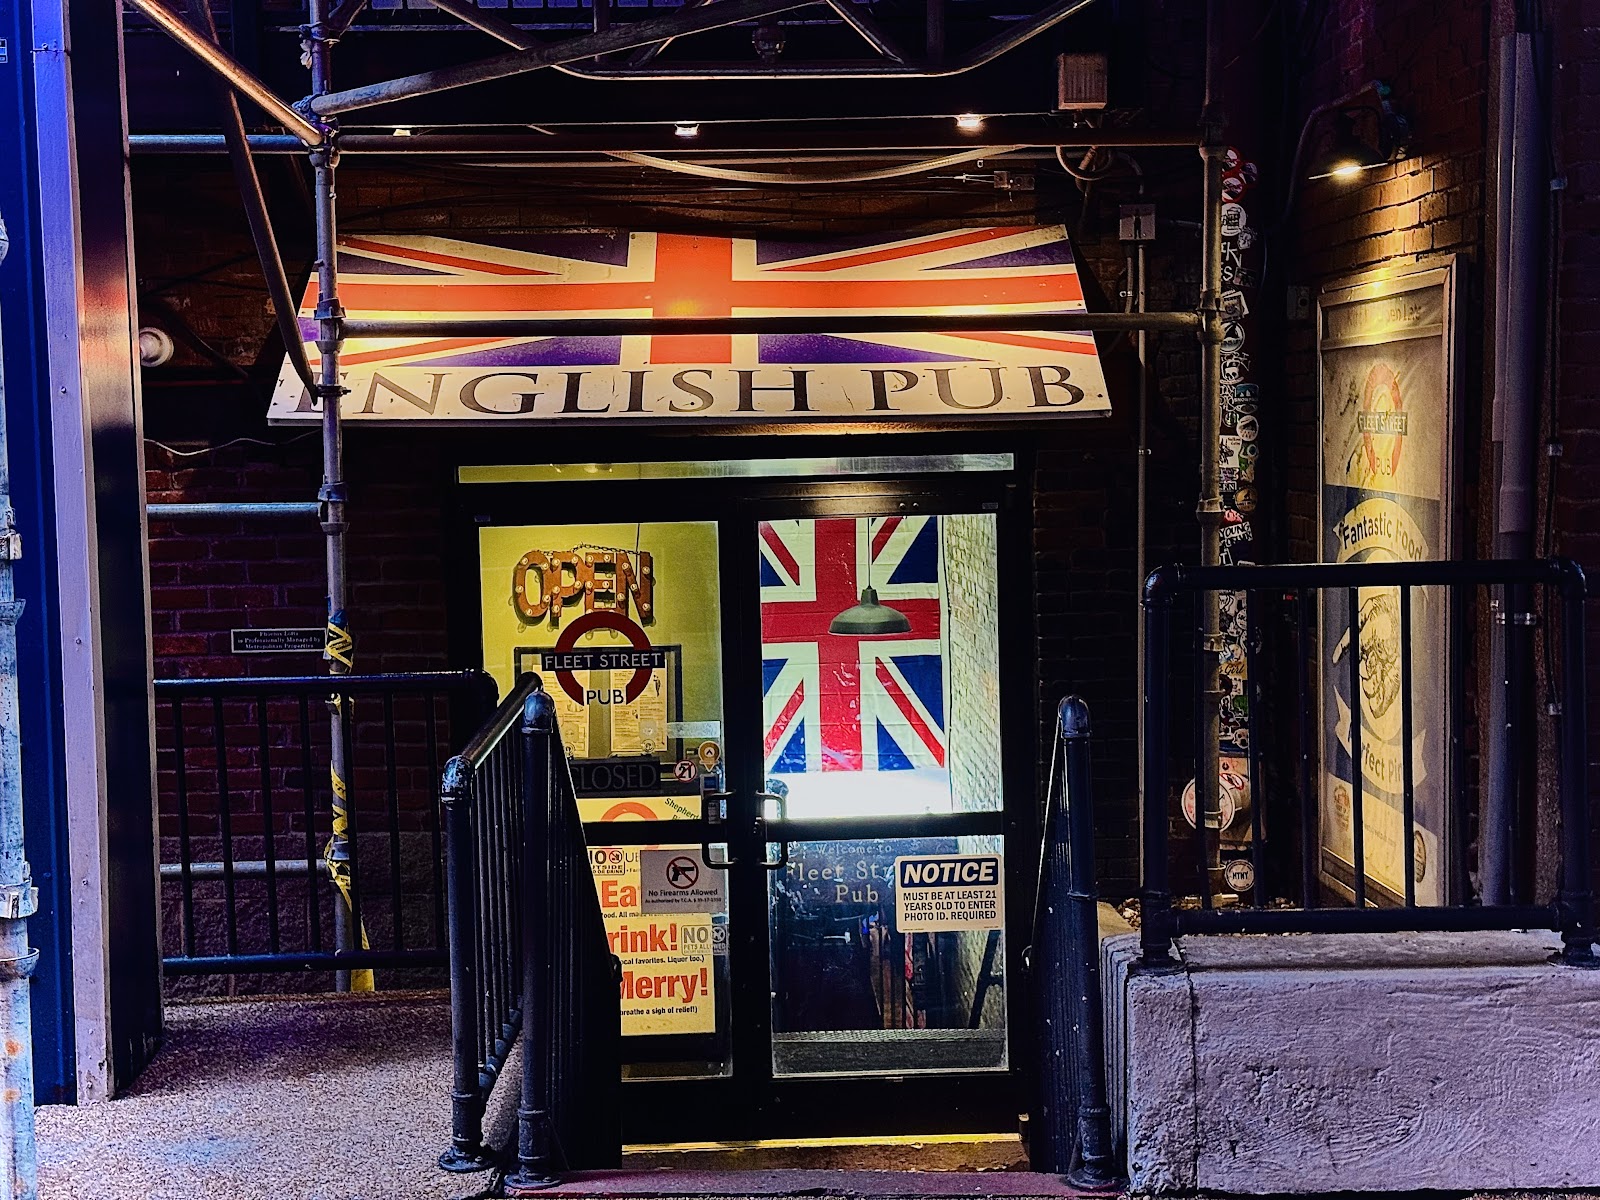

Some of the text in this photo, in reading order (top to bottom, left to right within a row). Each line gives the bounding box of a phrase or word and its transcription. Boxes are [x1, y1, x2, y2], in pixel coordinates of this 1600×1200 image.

[860, 365, 1086, 411] PUB
[1358, 414, 1407, 433] FLEET STREET
[1375, 456, 1392, 476] PUB
[1342, 511, 1393, 550] Fantastic
[513, 549, 654, 627] OPEN
[544, 652, 662, 670] FLEET STREET
[586, 689, 625, 706] PUB
[589, 850, 607, 865] O
[815, 843, 893, 855] Welcome to
[903, 861, 996, 884] NOTICE
[690, 888, 718, 896] Allowed
[835, 883, 879, 903] Pub
[903, 890, 997, 901] MUST BE AT LEAST 21
[904, 900, 996, 911] YEARS OLD TO ENTER
[904, 910, 996, 921] PHOTO ID. REQUIRED
[683, 926, 709, 943] NO
[635, 956, 666, 965] favorites.
[667, 956, 688, 964] Liquor
[651, 1007, 666, 1015] sigh
[667, 1006, 674, 1014] of
